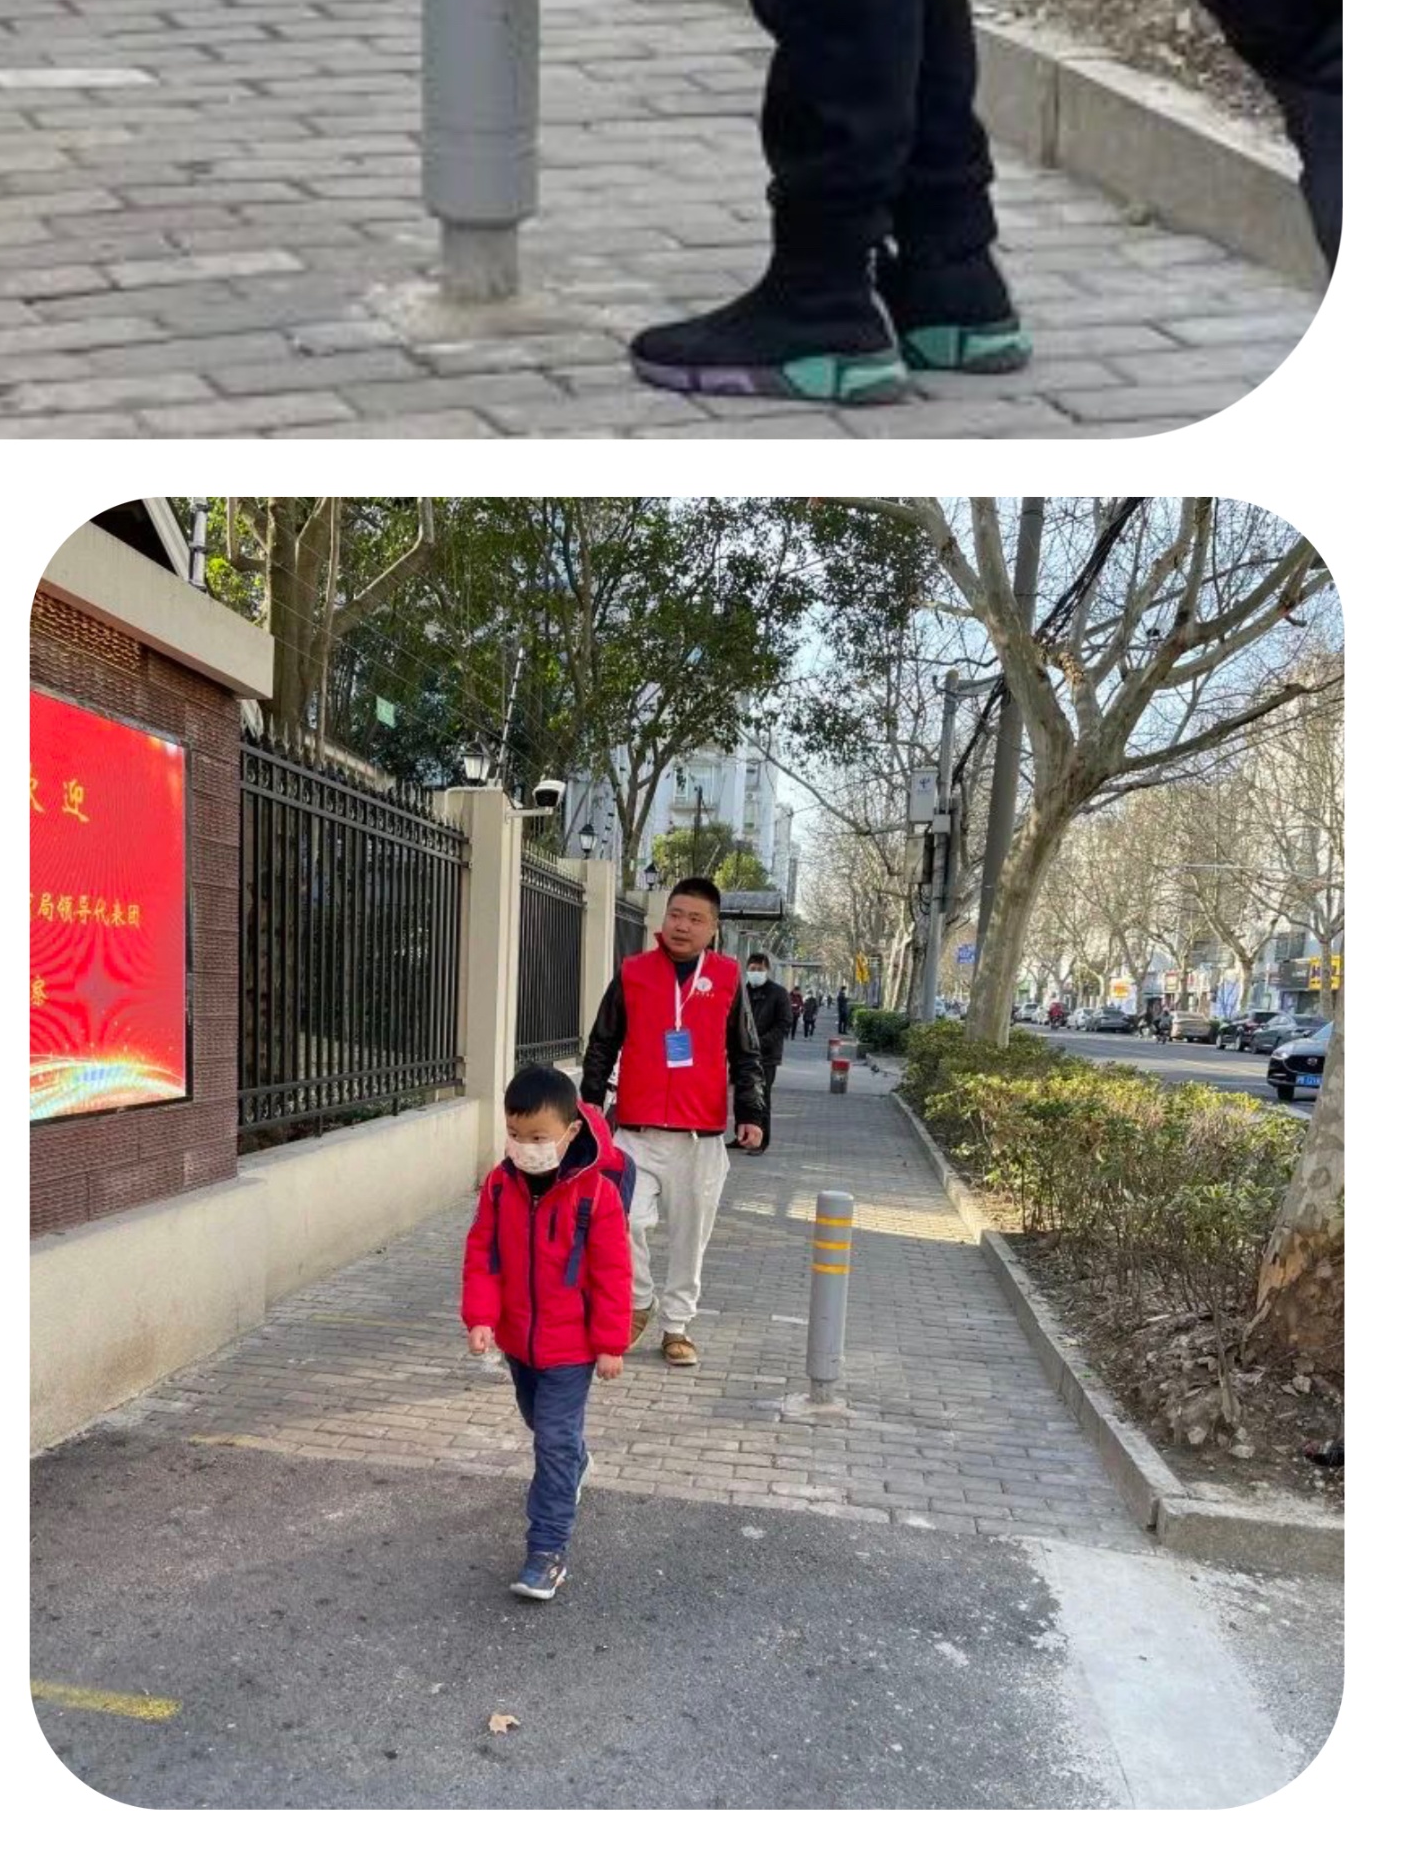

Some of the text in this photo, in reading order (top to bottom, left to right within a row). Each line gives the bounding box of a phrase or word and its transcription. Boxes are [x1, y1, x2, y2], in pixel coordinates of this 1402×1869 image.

[30, 892, 141, 927] 局领导代表团
